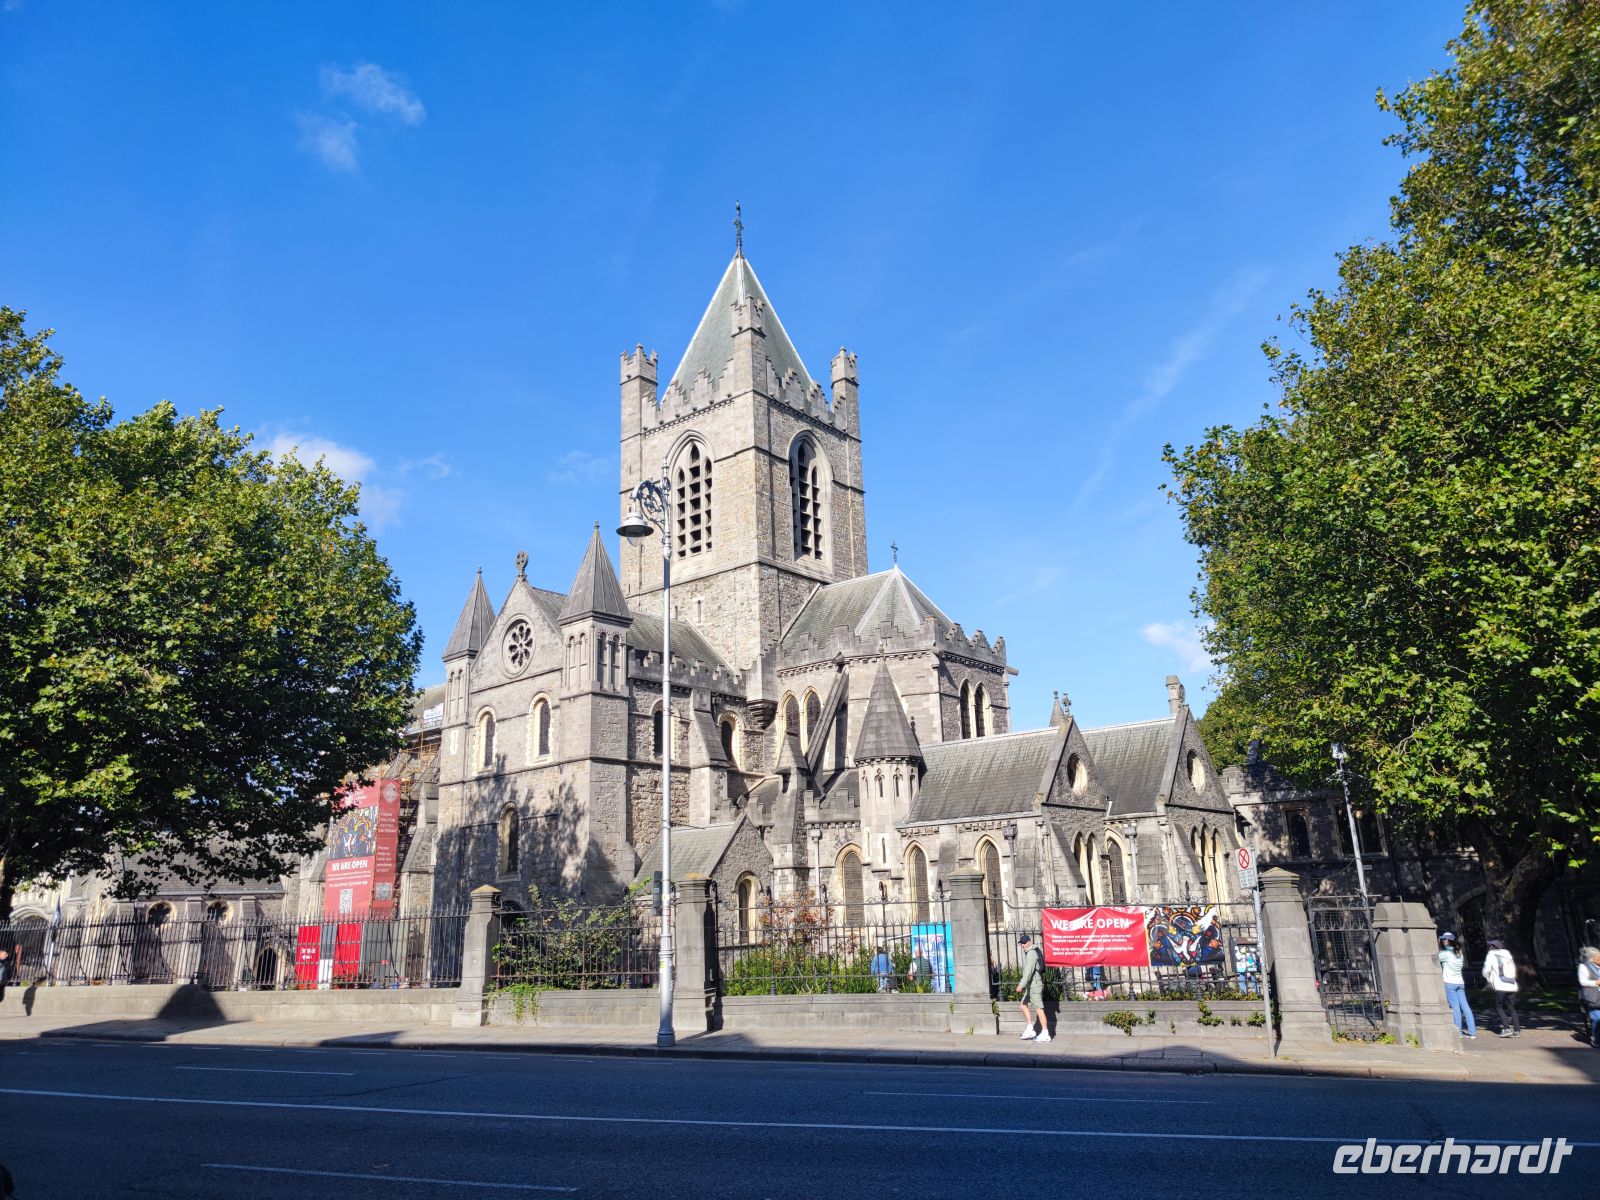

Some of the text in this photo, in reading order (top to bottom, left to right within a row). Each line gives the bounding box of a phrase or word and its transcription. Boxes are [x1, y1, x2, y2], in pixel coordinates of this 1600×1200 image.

[332, 863, 340, 871] WE
[340, 861, 351, 870] ARE
[351, 859, 368, 869] OPEN
[1050, 917, 1129, 929] WE RE OPEN
